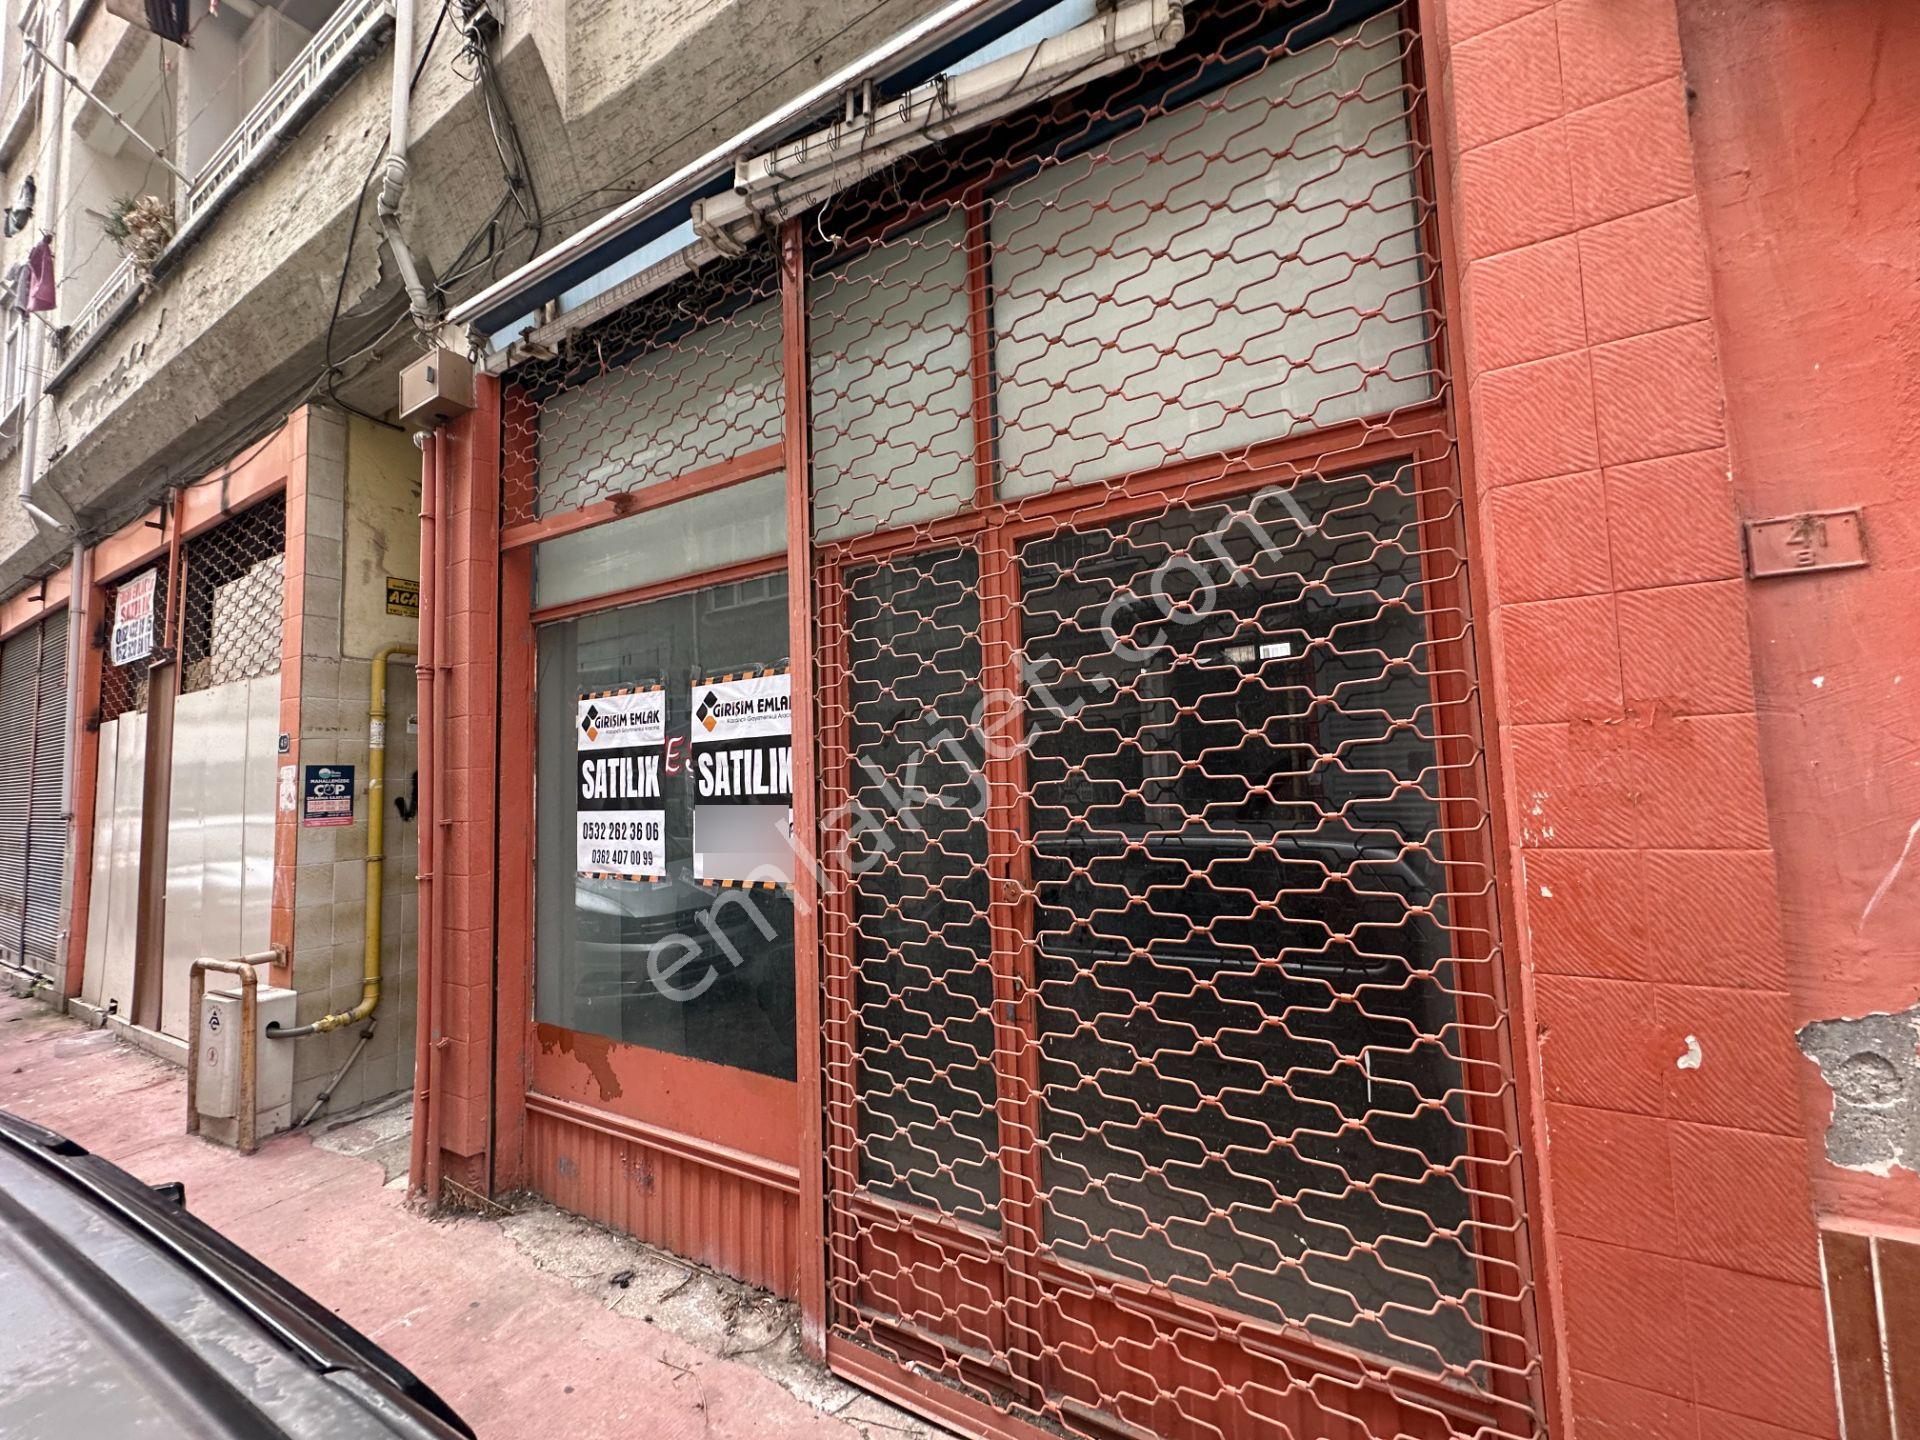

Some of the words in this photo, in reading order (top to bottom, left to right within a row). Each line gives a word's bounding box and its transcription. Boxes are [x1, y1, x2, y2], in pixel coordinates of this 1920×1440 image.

[629, 709, 659, 726] EMLAK
[582, 755, 660, 799] SATILIK
[698, 746, 793, 797] SATILIK
[583, 822, 606, 840] 0532
[609, 822, 627, 840] 262
[630, 822, 643, 841] 36
[645, 822, 659, 841] 06
[592, 849, 610, 864] 0362
[612, 849, 629, 865] 407
[630, 850, 641, 866] 00
[643, 851, 654, 866] 99
